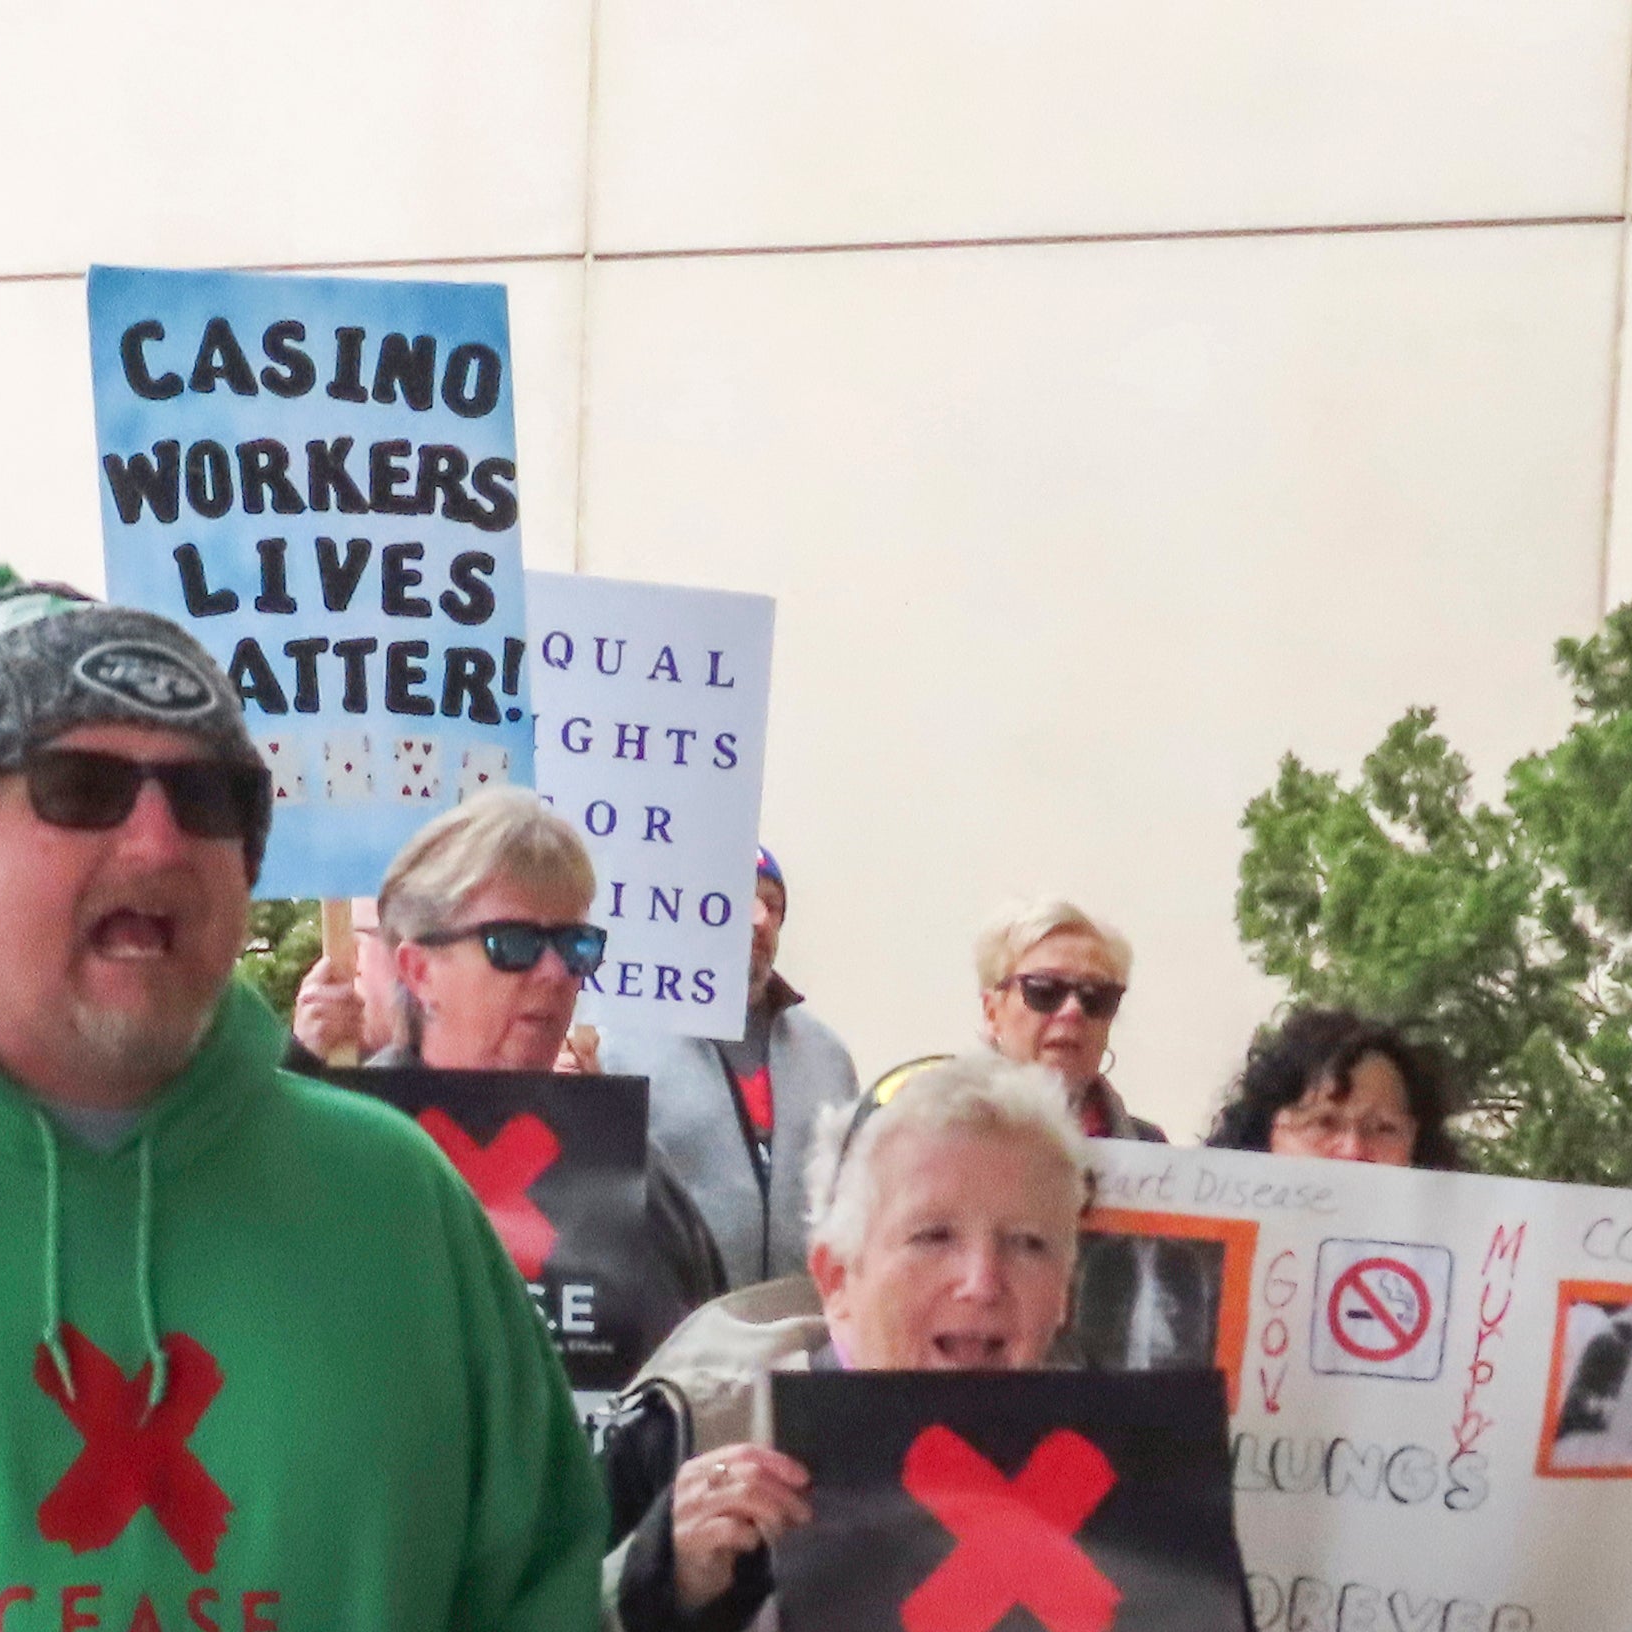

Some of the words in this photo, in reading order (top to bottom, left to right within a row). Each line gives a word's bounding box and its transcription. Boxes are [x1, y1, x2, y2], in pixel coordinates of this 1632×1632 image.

[120, 316, 503, 419] CASINO
[102, 436, 519, 532] WORKERS
[173, 536, 496, 625] LIVES
[227, 636, 525, 725] ATTER!
[541, 630, 736, 689] QUAL
[539, 795, 675, 844] OR
[609, 882, 733, 928] INO
[1231, 1432, 1491, 1510] LUNGS
